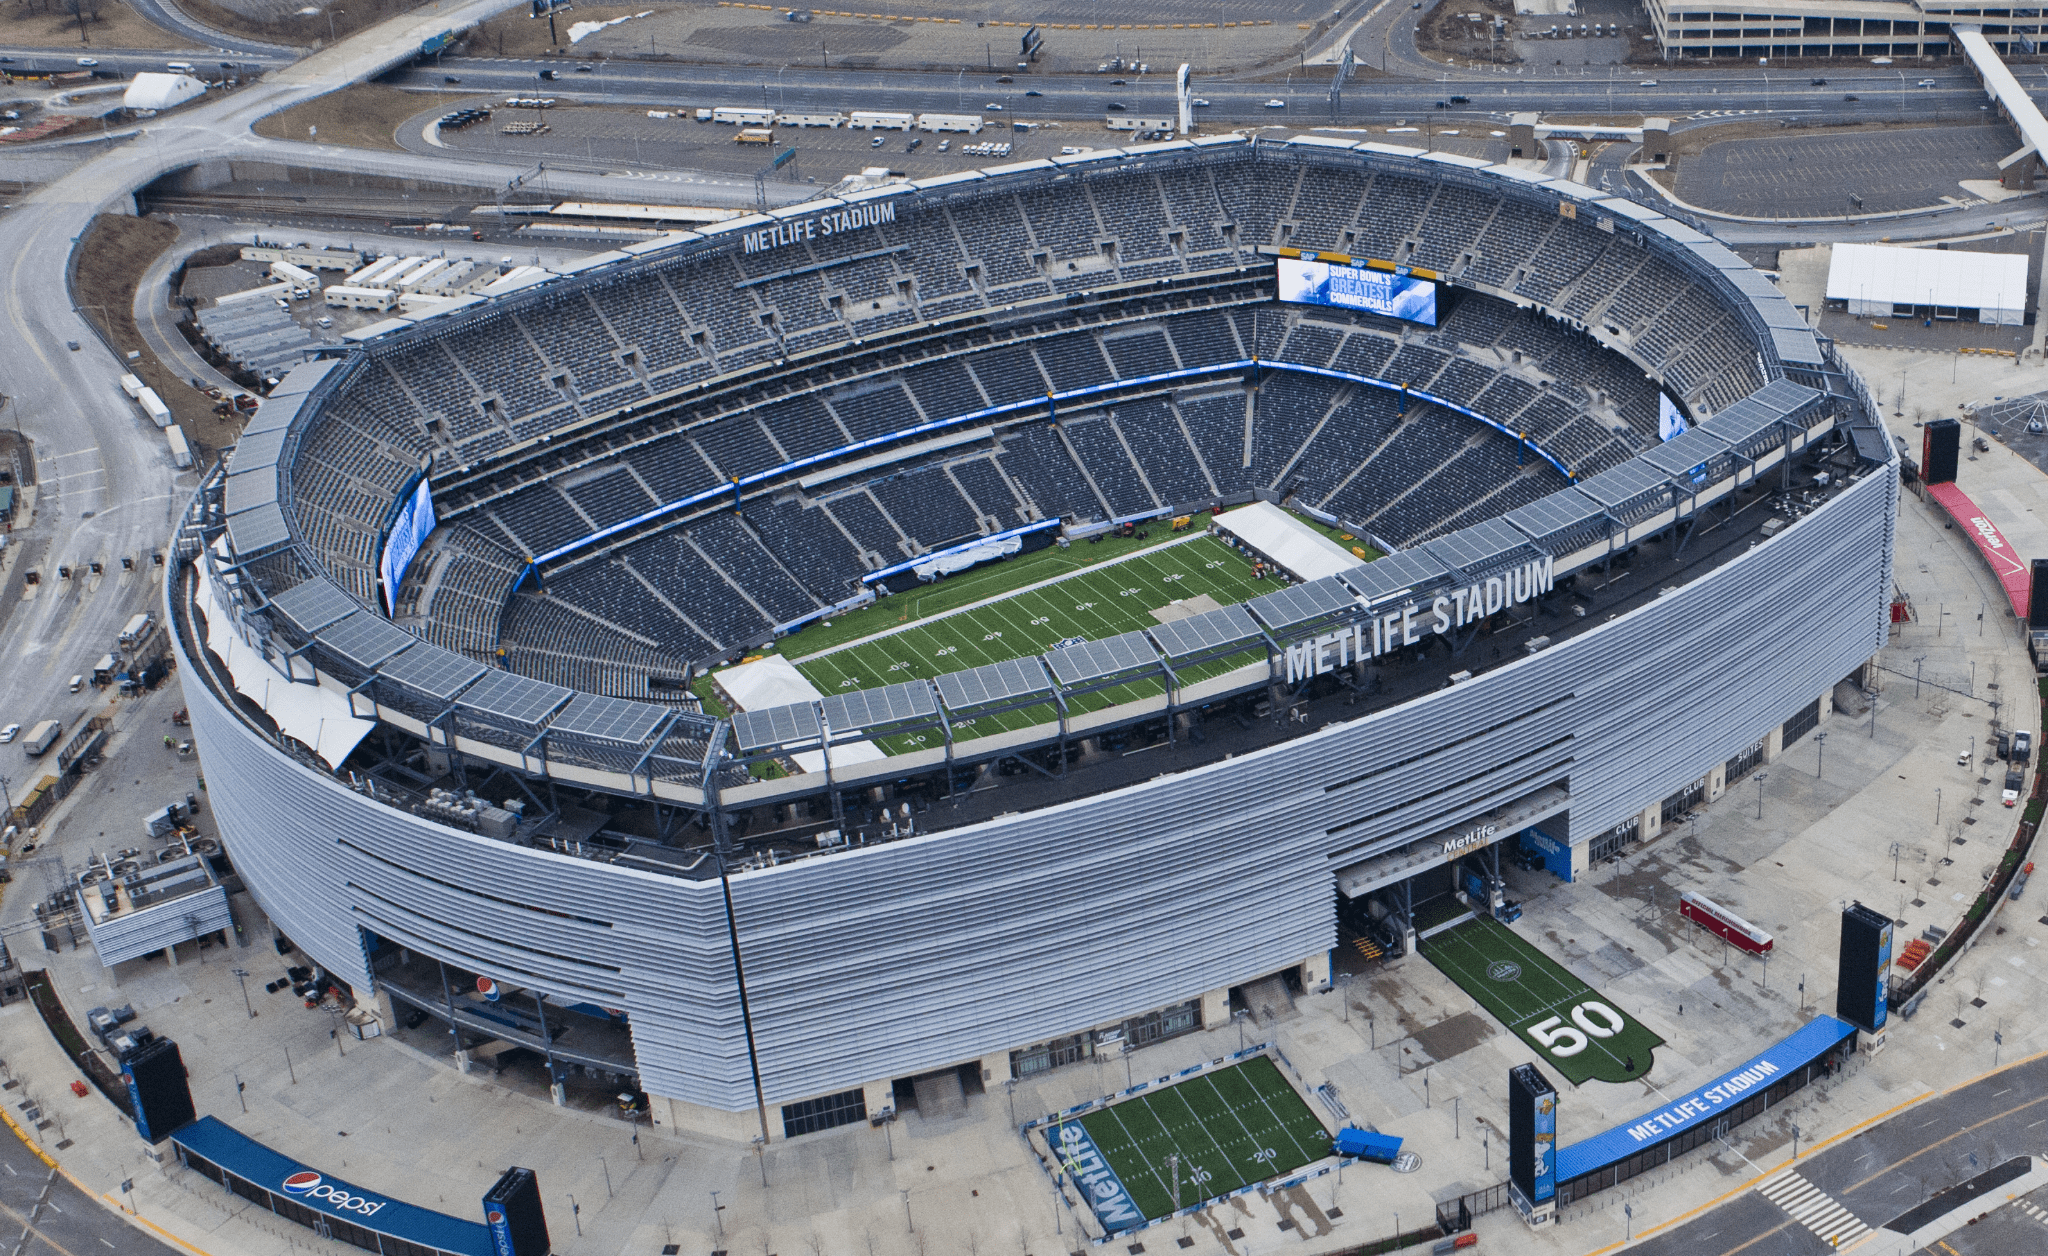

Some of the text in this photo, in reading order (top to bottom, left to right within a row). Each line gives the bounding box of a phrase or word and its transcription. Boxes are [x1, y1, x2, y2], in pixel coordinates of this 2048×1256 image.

[743, 202, 896, 254] METLIFE STADIUM
[1301, 252, 1315, 261] SAP
[1351, 259, 1365, 268] SAP
[1329, 266, 1391, 285] SUPER BOWL'S
[1396, 266, 1409, 275] SAP
[1330, 278, 1391, 300] GREATEST
[1330, 292, 1393, 311] COMMERCIALS
[1530, 303, 1600, 348] MetLife
[1970, 517, 2004, 548] verizon
[1286, 554, 1554, 684] METLIFE STADIUM
[1738, 740, 1763, 763] SUITES
[1684, 778, 1705, 796] CLUB
[1616, 816, 1639, 835] CLUB
[1443, 825, 1495, 854] MetLife
[1527, 1001, 1624, 1058] 50
[1627, 1060, 1780, 1142] METLIFE STADIUM
[1253, 1148, 1277, 1164] 20
[1056, 1126, 1138, 1224] MetLife
[1190, 1170, 1212, 1186] 10
[305, 1184, 387, 1217] pepsi
